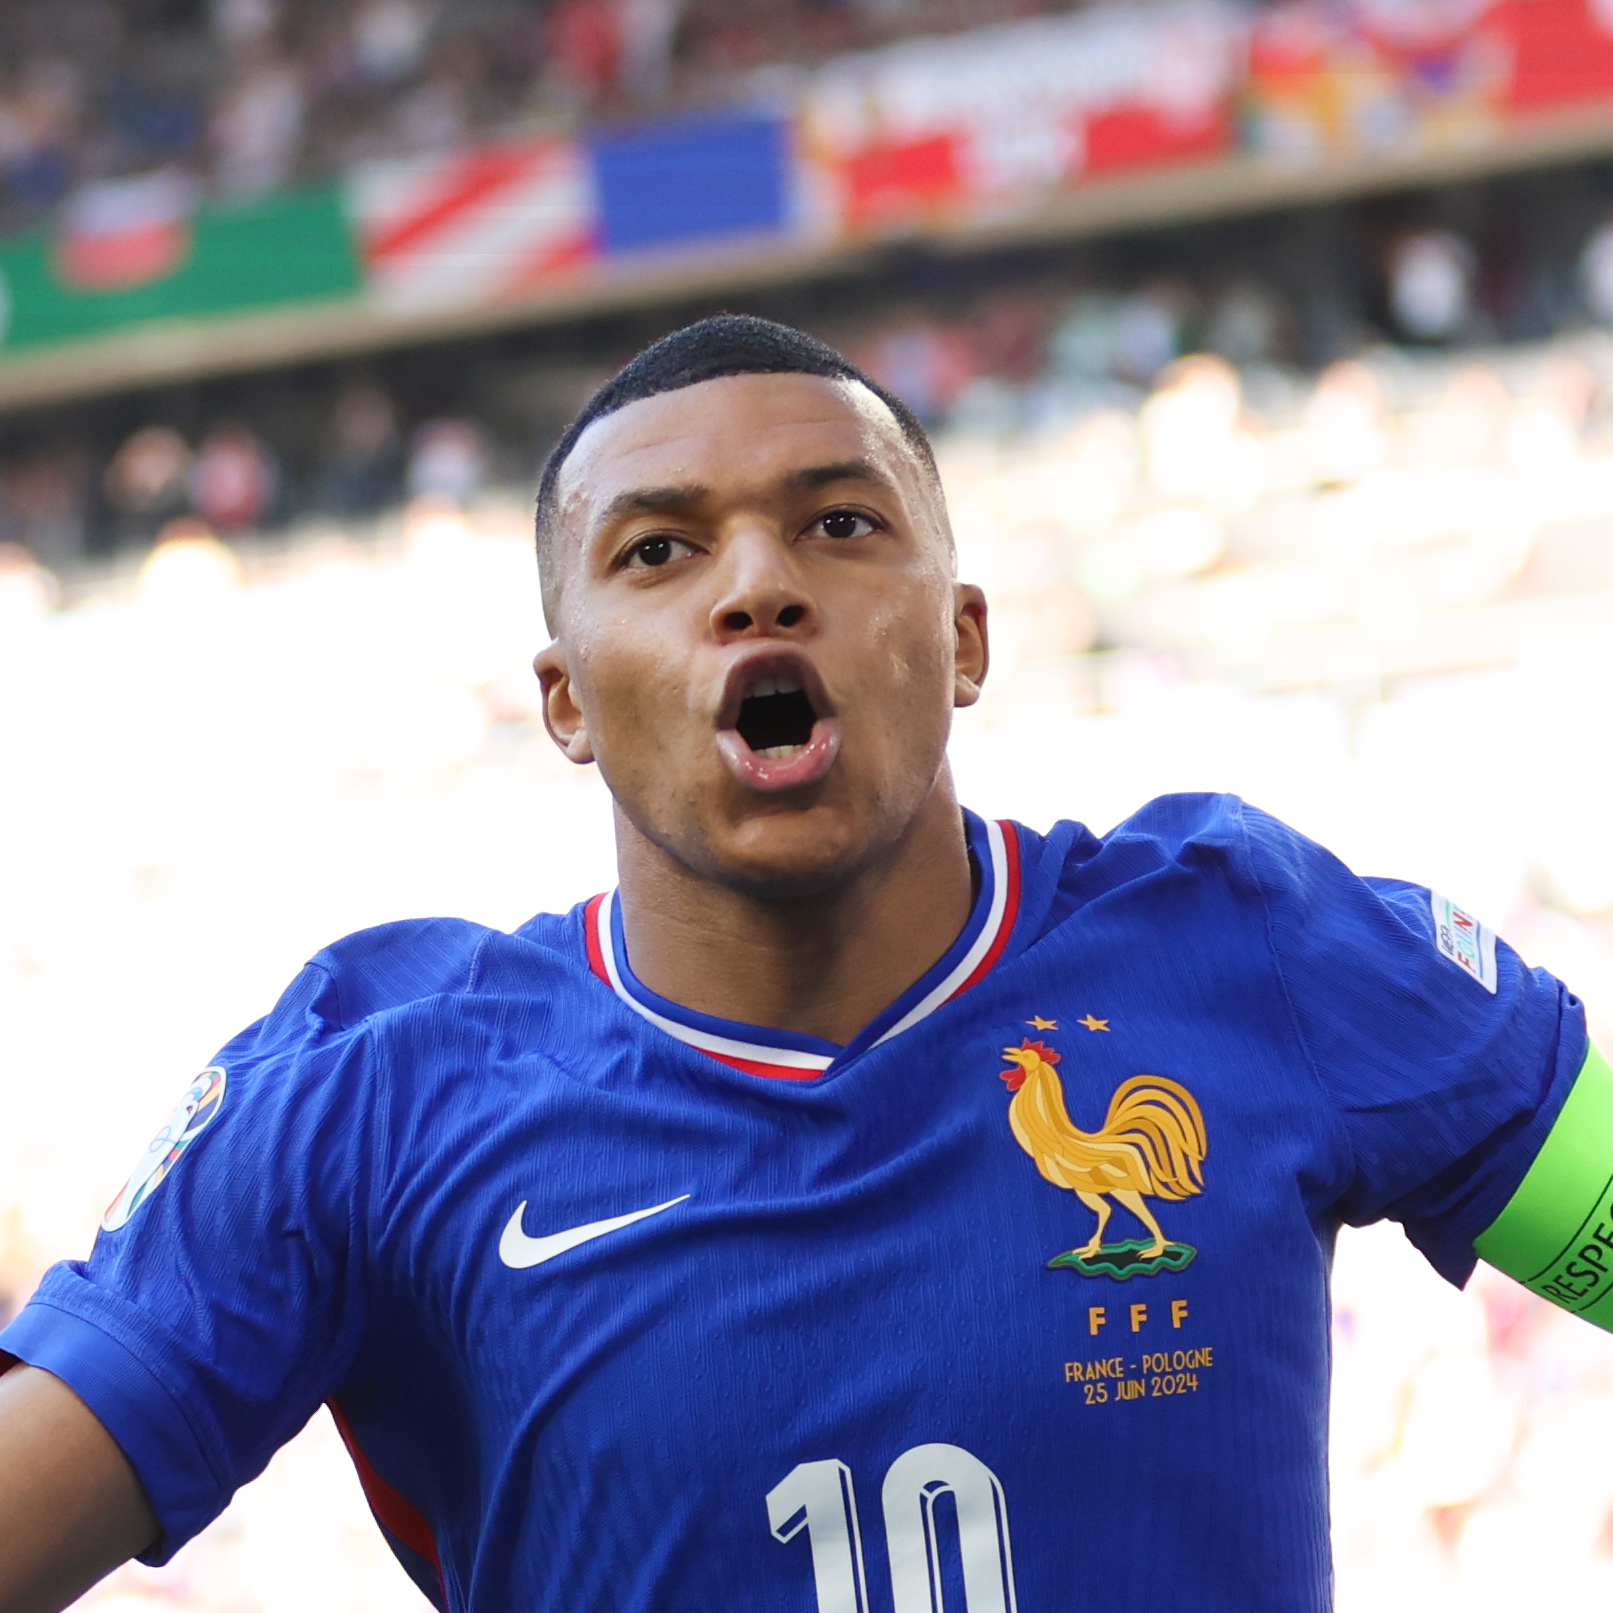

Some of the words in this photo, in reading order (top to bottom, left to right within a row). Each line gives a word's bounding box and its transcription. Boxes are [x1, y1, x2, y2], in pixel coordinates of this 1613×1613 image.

[1064, 1357, 1124, 1383] FRANCE
[1142, 1347, 1213, 1374] POLOGNE
[1083, 1382, 1109, 1405] 25
[1114, 1379, 1146, 1401] JUIN
[1151, 1373, 1199, 1397] 2024
